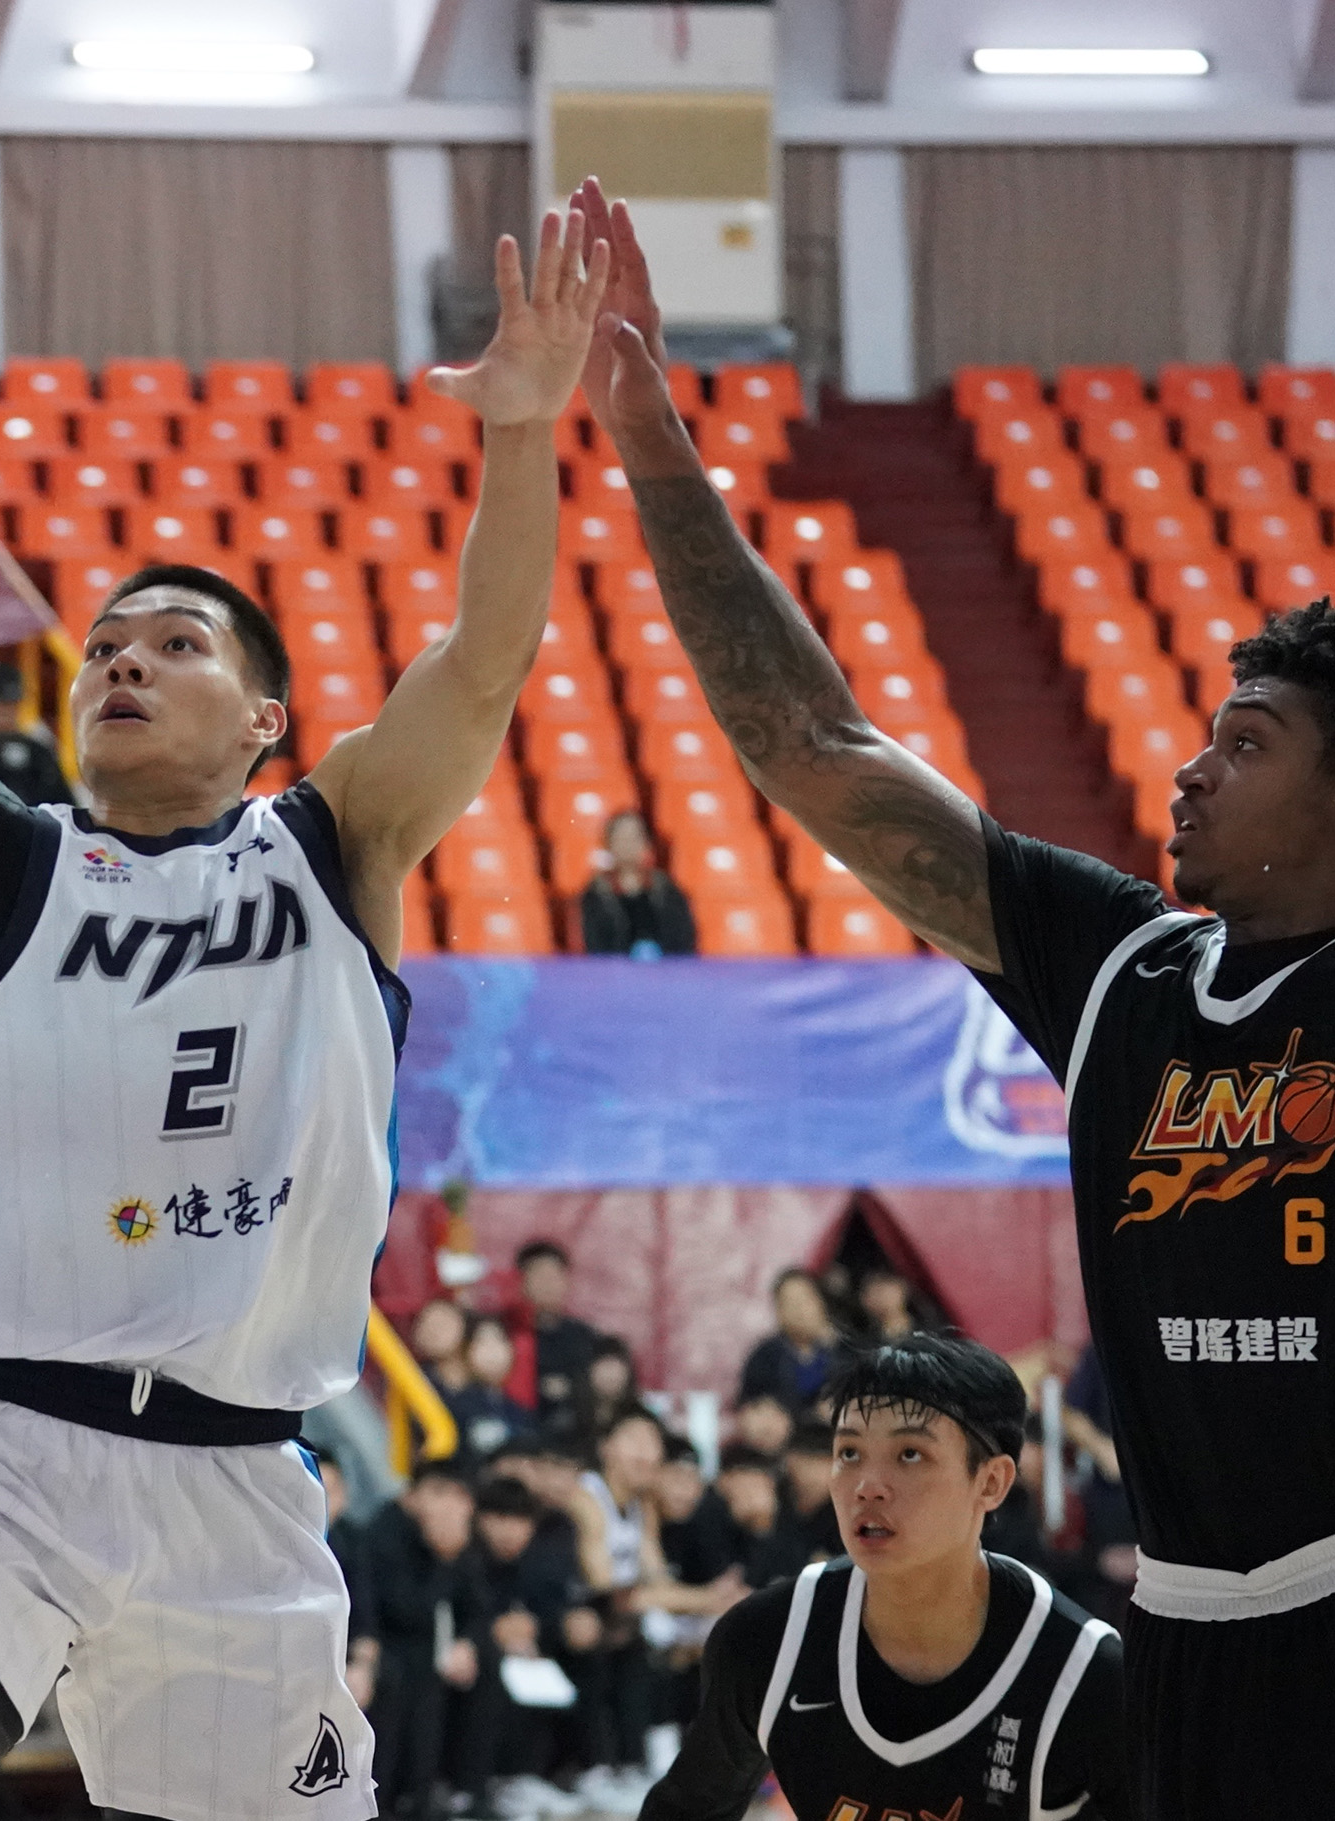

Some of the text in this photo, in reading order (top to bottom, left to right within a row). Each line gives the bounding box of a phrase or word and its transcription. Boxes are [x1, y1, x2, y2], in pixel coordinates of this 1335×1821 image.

[55, 874, 311, 1008] NTUA
[159, 1022, 248, 1142] 2
[1284, 1197, 1326, 1266] 6
